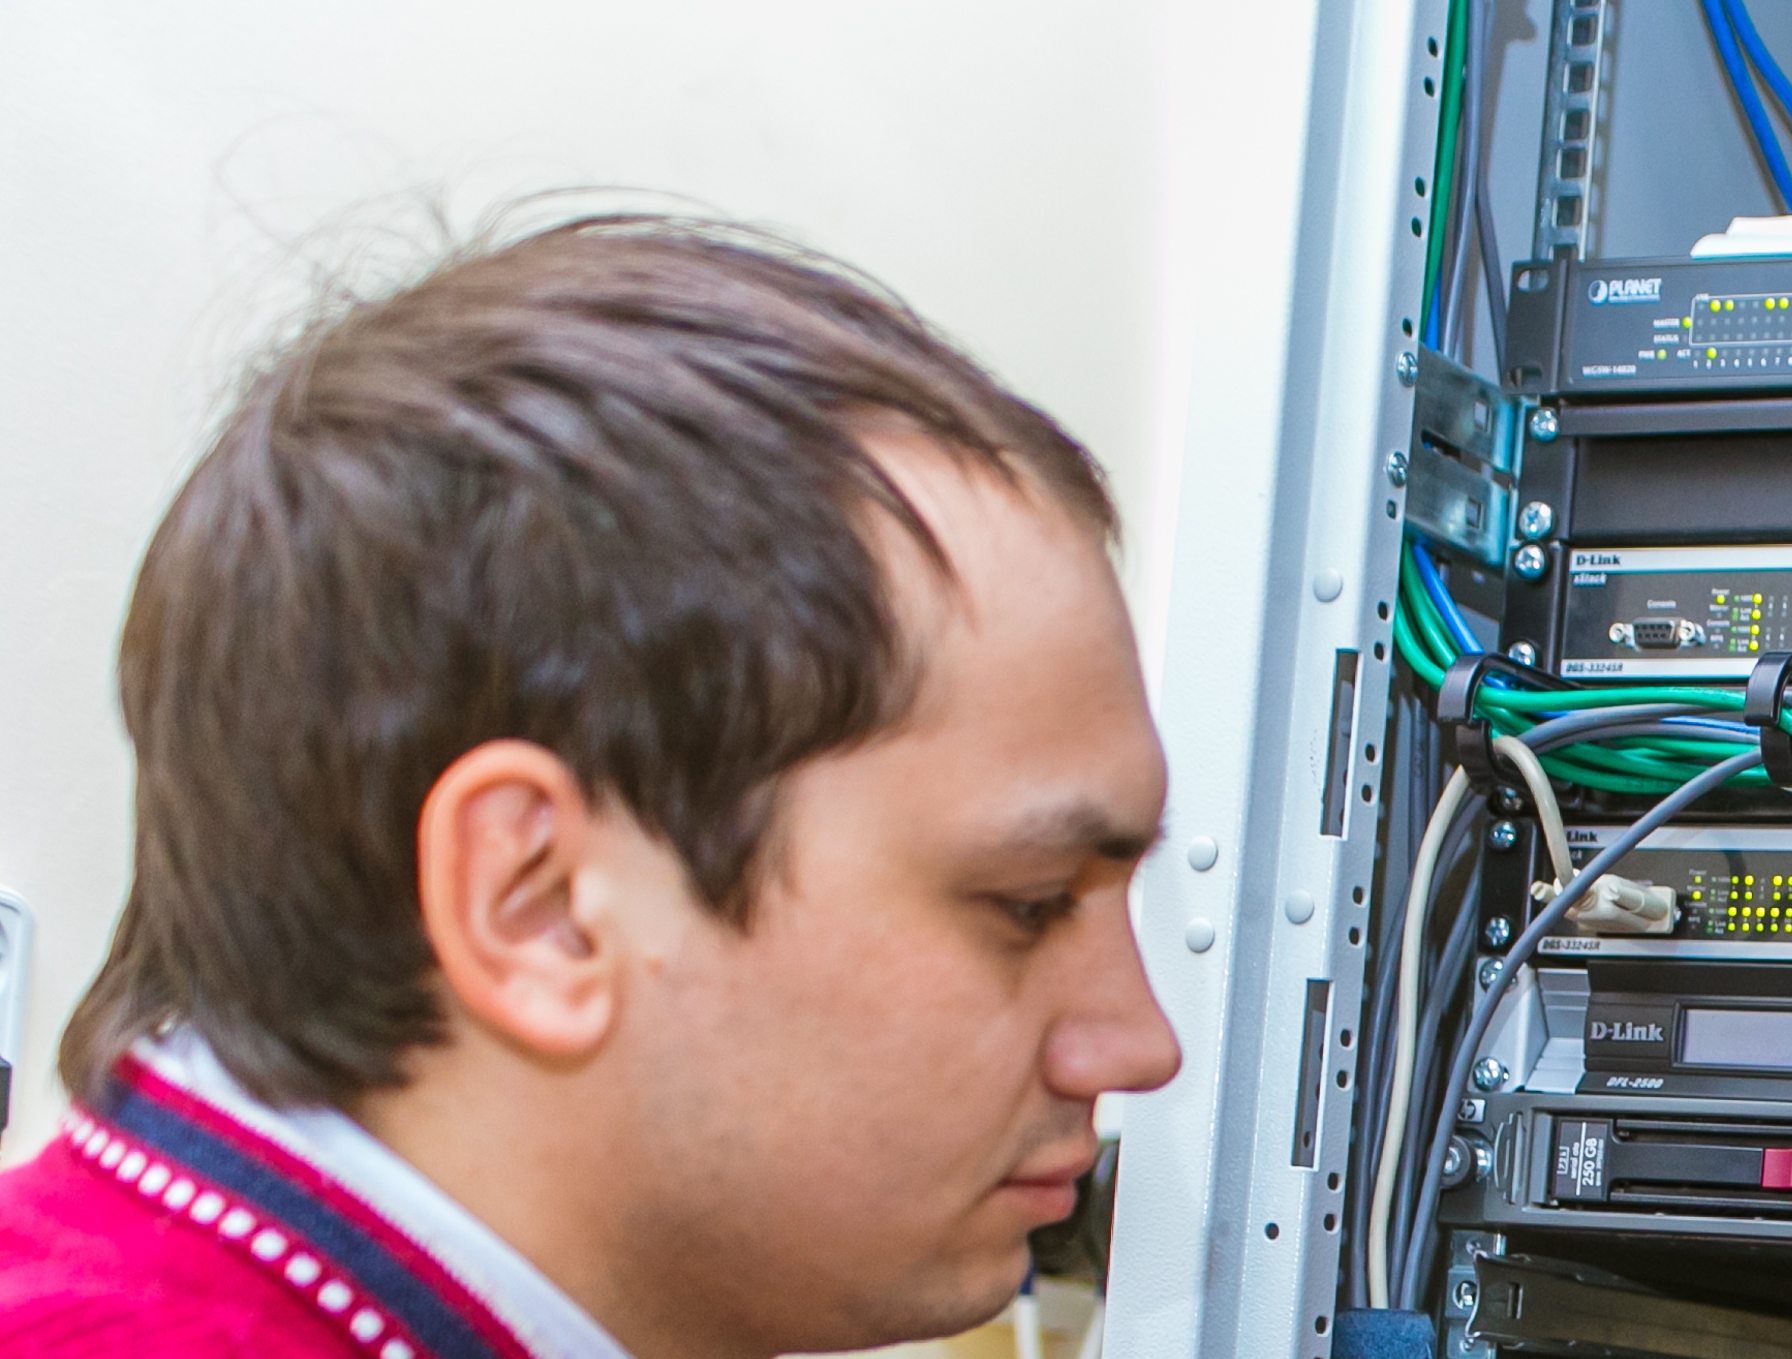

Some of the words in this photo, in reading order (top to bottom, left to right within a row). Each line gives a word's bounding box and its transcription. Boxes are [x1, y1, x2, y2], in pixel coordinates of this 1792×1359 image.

[1609, 278, 1662, 296] PLANET
[1653, 318, 1680, 328] MASTER
[1575, 555, 1621, 566] D-Link
[1566, 662, 1623, 673] DGS-3324SR
[1542, 939, 1601, 950] DGS-3324SR
[1590, 1021, 1664, 1041] D-Link
[1606, 1076, 1664, 1089] DFL-2500
[1584, 1137, 1597, 1158] GB
[1582, 1161, 1595, 1186] 250
